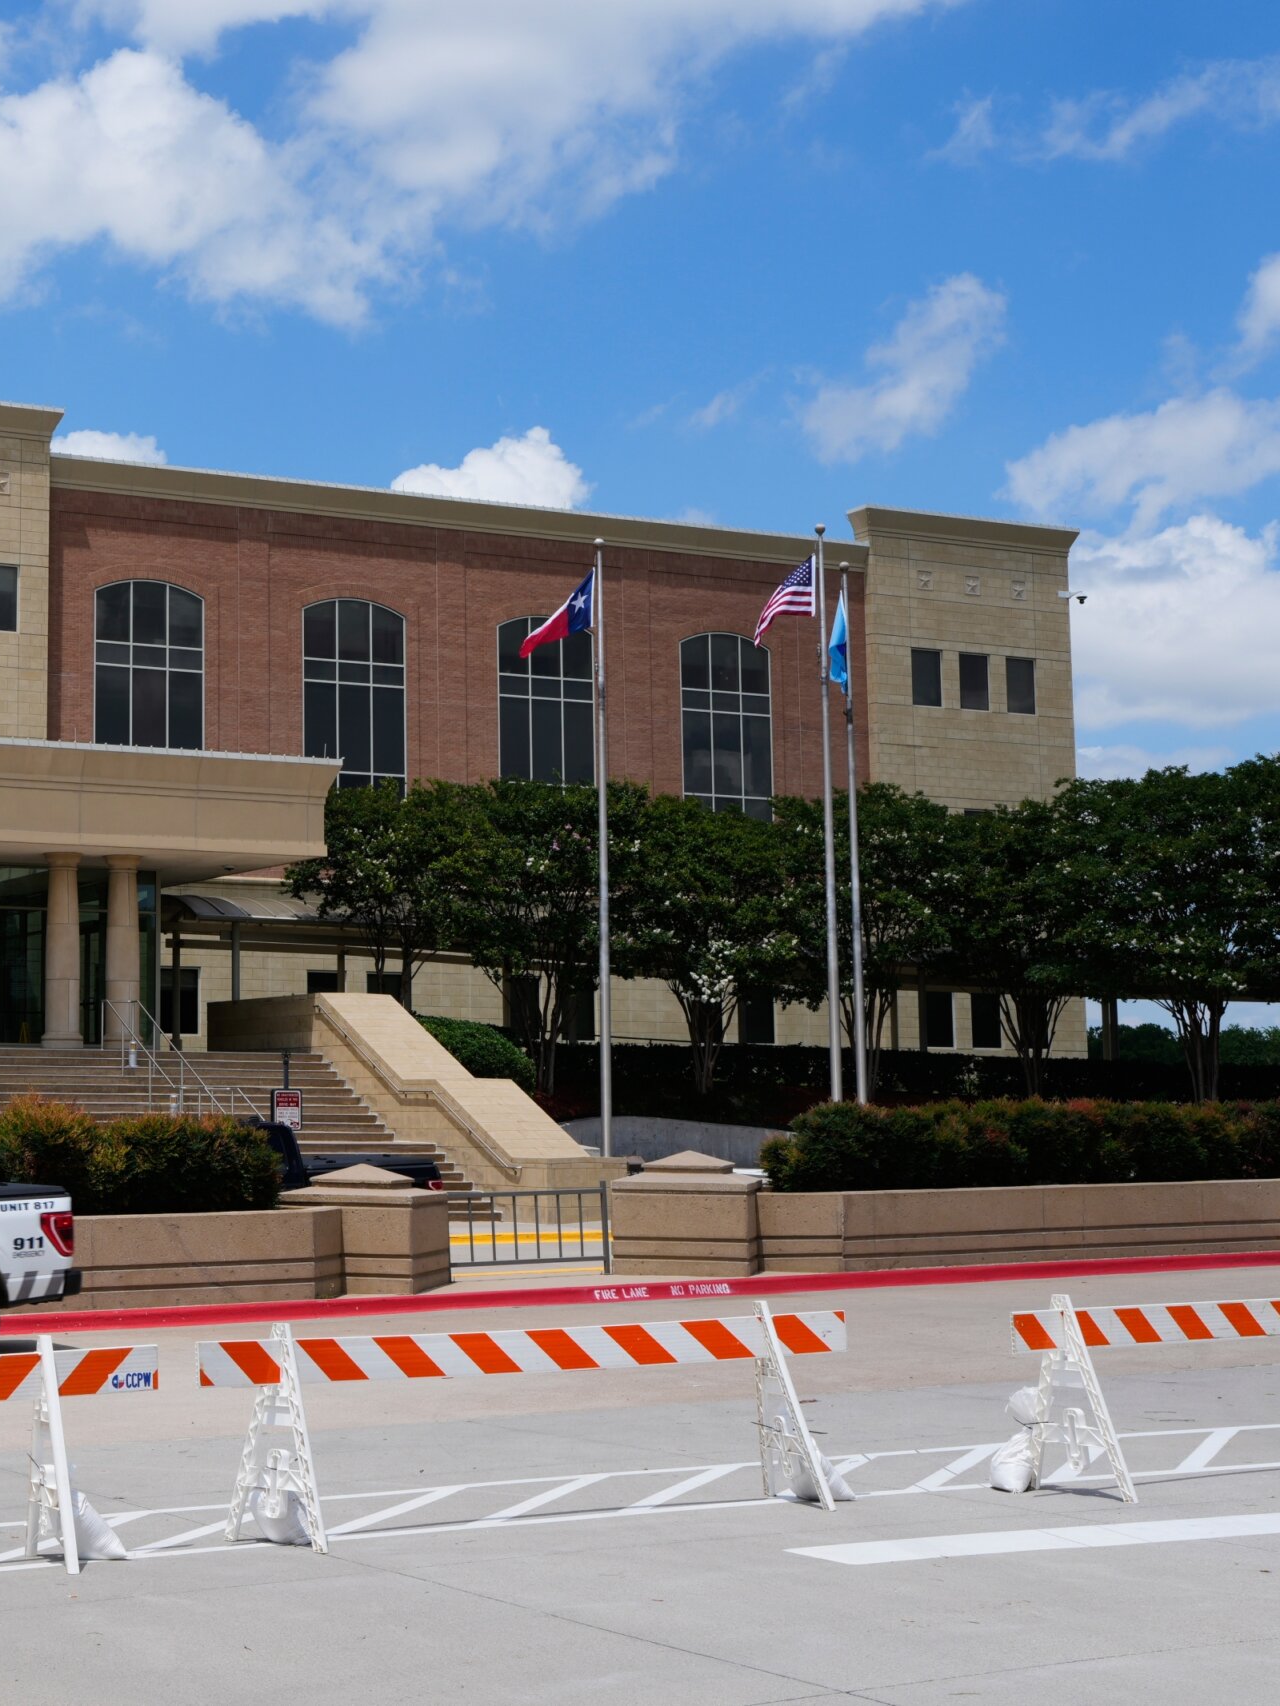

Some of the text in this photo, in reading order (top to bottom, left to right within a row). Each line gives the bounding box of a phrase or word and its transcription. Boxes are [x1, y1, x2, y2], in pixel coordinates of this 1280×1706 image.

[0, 1201, 54, 1212] UNIT 817
[13, 1236, 44, 1250] 911
[593, 1283, 731, 1300] FIRE LANE NO PARKING
[125, 1371, 151, 1389] CCPW
